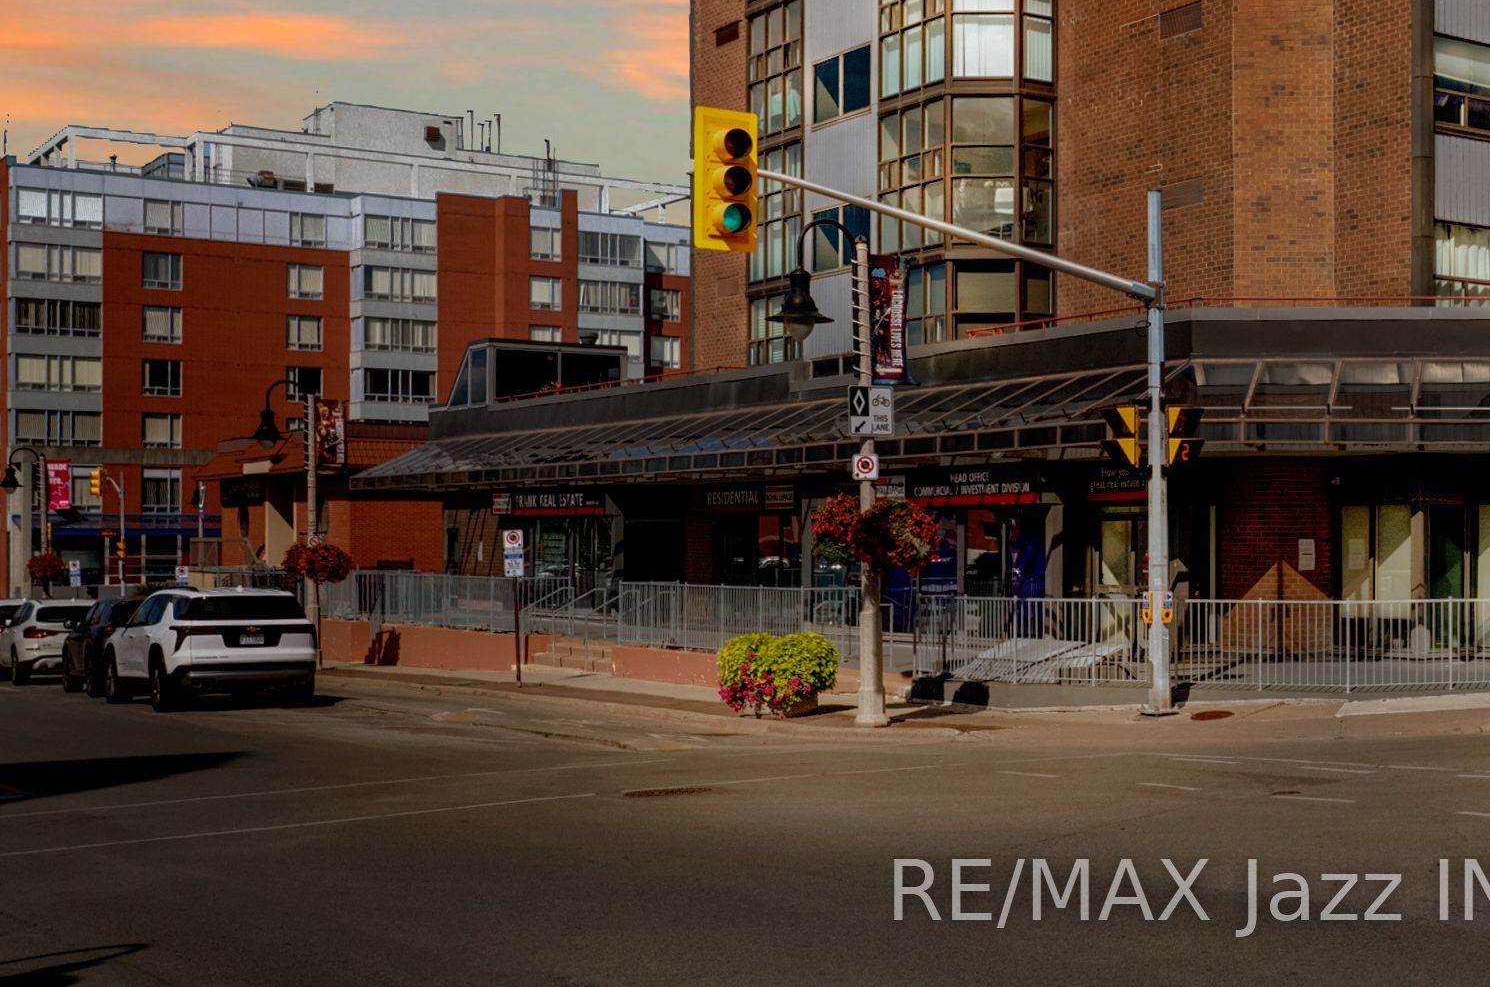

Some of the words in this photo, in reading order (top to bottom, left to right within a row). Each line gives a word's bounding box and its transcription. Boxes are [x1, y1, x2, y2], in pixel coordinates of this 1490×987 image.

[873, 415, 888, 423] THIS
[871, 424, 890, 432] LANE
[950, 472, 969, 483] HEAD
[969, 471, 990, 482] OFFICE
[914, 485, 953, 497] COMMERCIAL
[960, 483, 1000, 495] INVESTMENT
[1001, 482, 1030, 493] DIVISION
[540, 494, 557, 507] REAL
[559, 493, 583, 506] ESTATE
[707, 491, 759, 505] RESIDENTIAL
